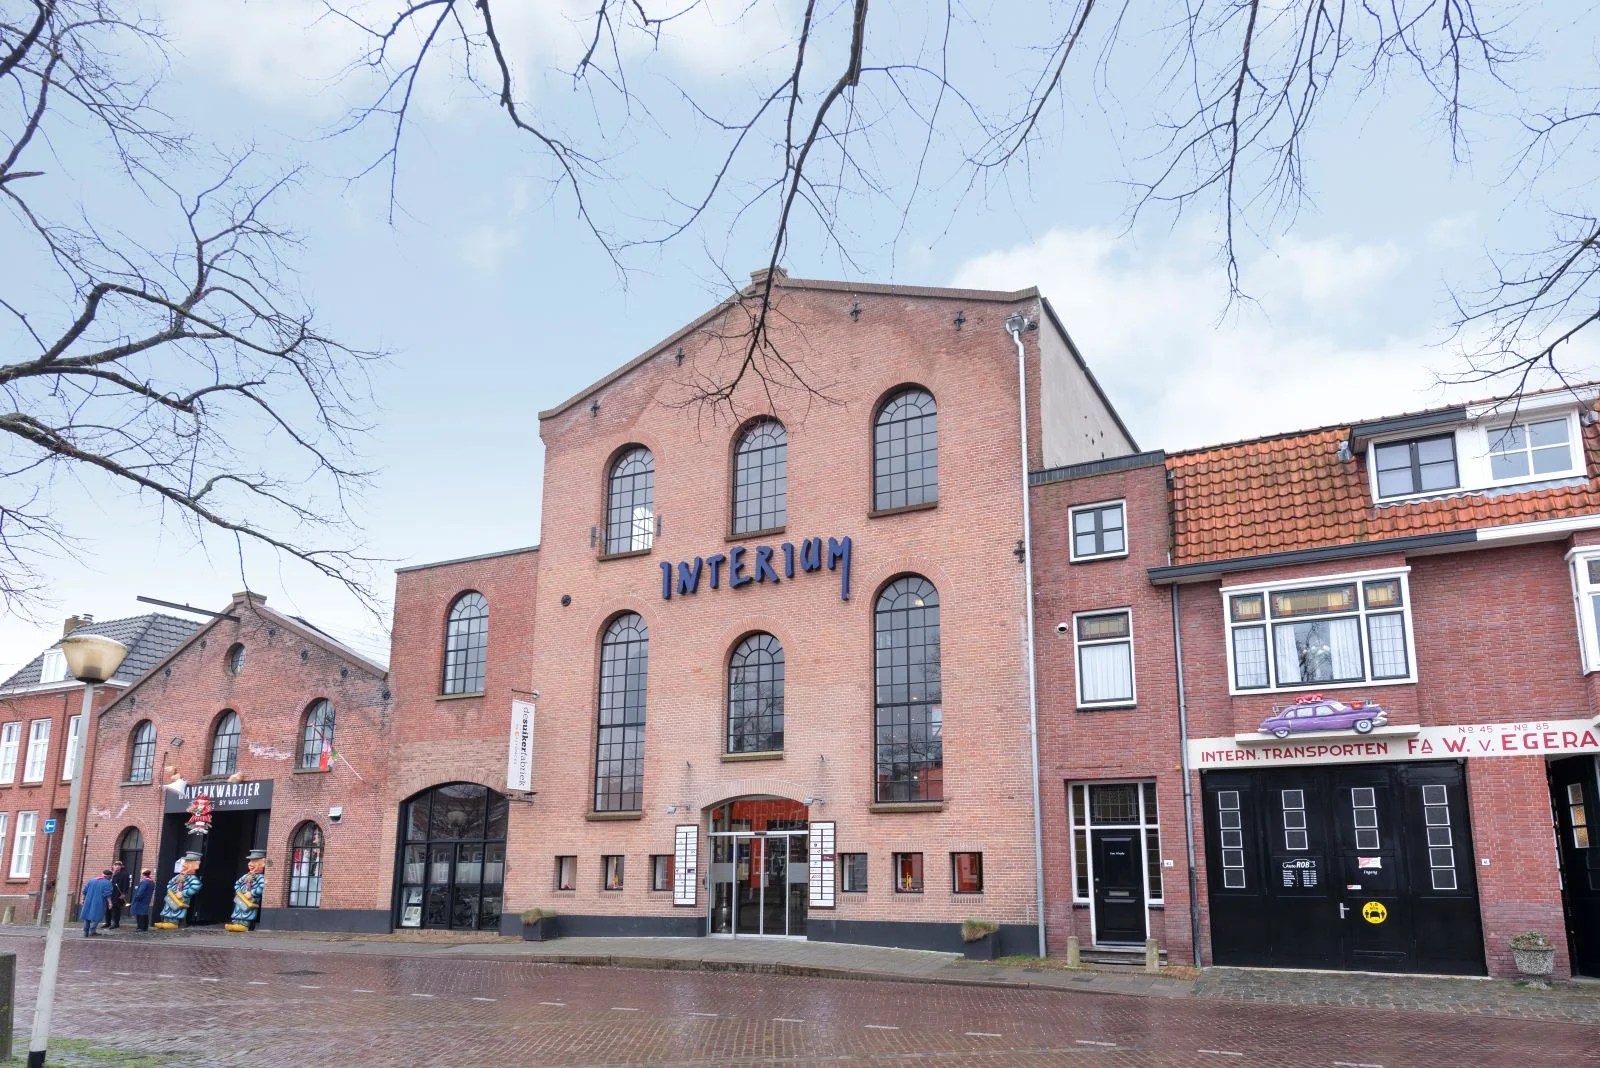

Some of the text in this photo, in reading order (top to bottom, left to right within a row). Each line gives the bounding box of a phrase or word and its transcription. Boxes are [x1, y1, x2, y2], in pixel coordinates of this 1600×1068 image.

[659, 536, 852, 601] INTERIUM
[1479, 725, 1494, 733] 45
[1535, 722, 1550, 731] 85
[1201, 749, 1261, 763] INTERN.
[1262, 742, 1389, 760] TRANSPORTEN
[1442, 736, 1471, 753] W.
